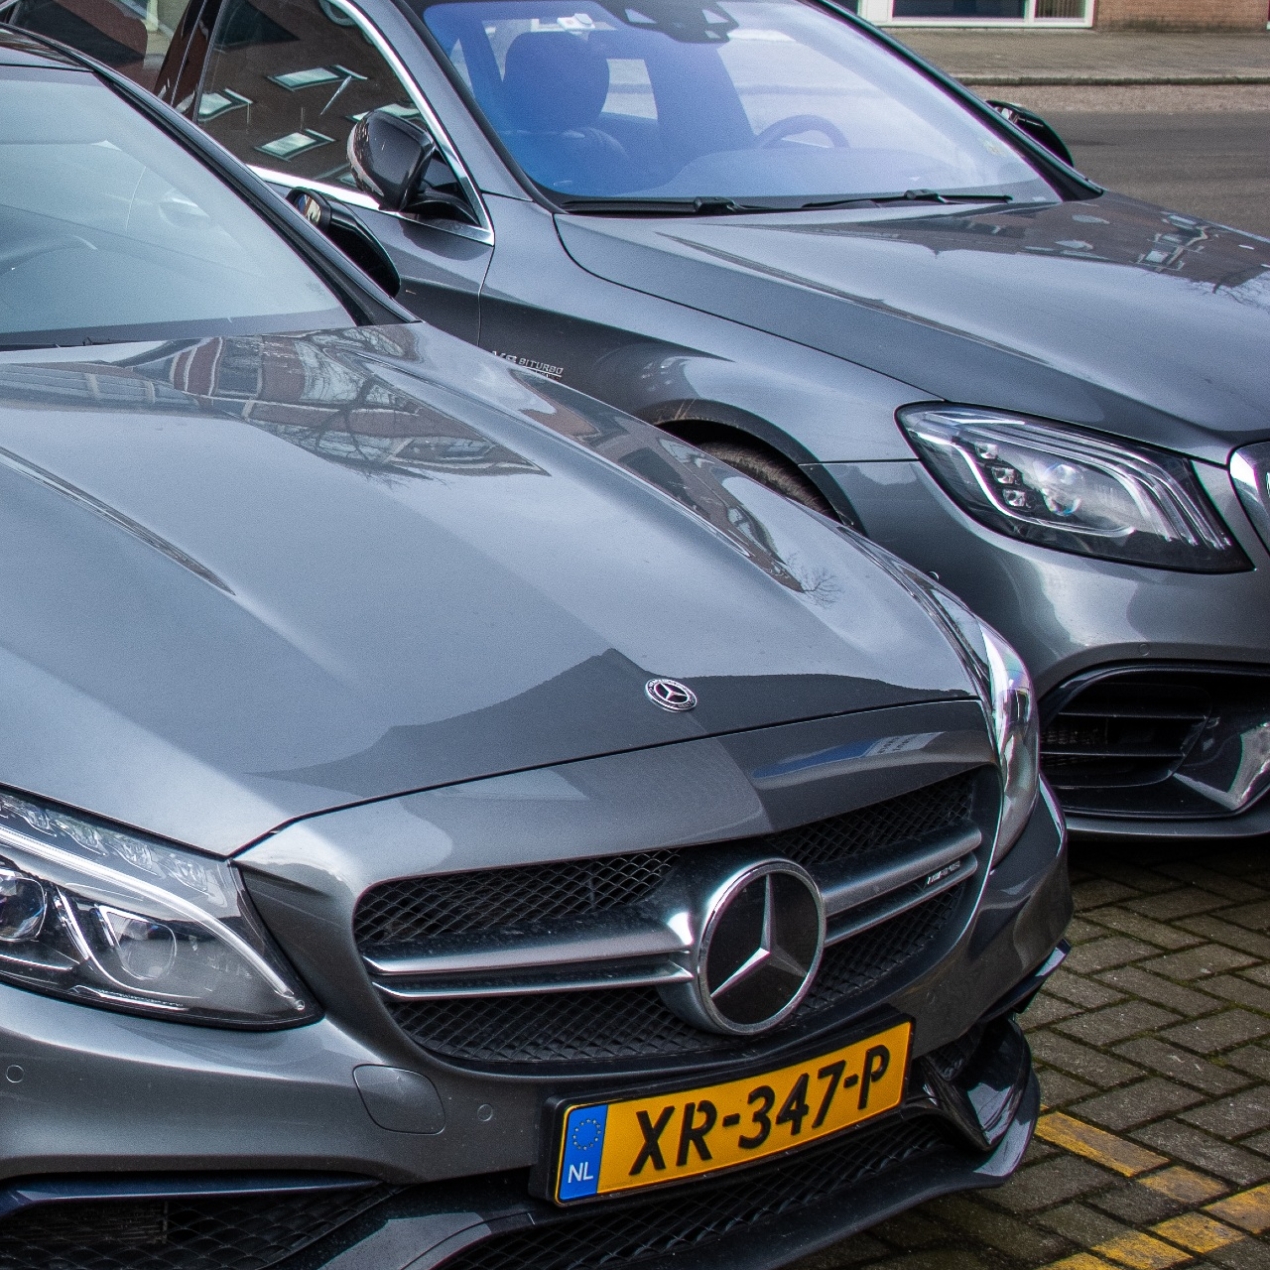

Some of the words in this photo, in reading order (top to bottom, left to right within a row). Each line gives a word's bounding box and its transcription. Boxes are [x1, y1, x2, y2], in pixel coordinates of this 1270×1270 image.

[518, 357, 564, 375] BITURBO
[567, 1163, 594, 1184] NL
[628, 1044, 891, 1177] XR-347-P
